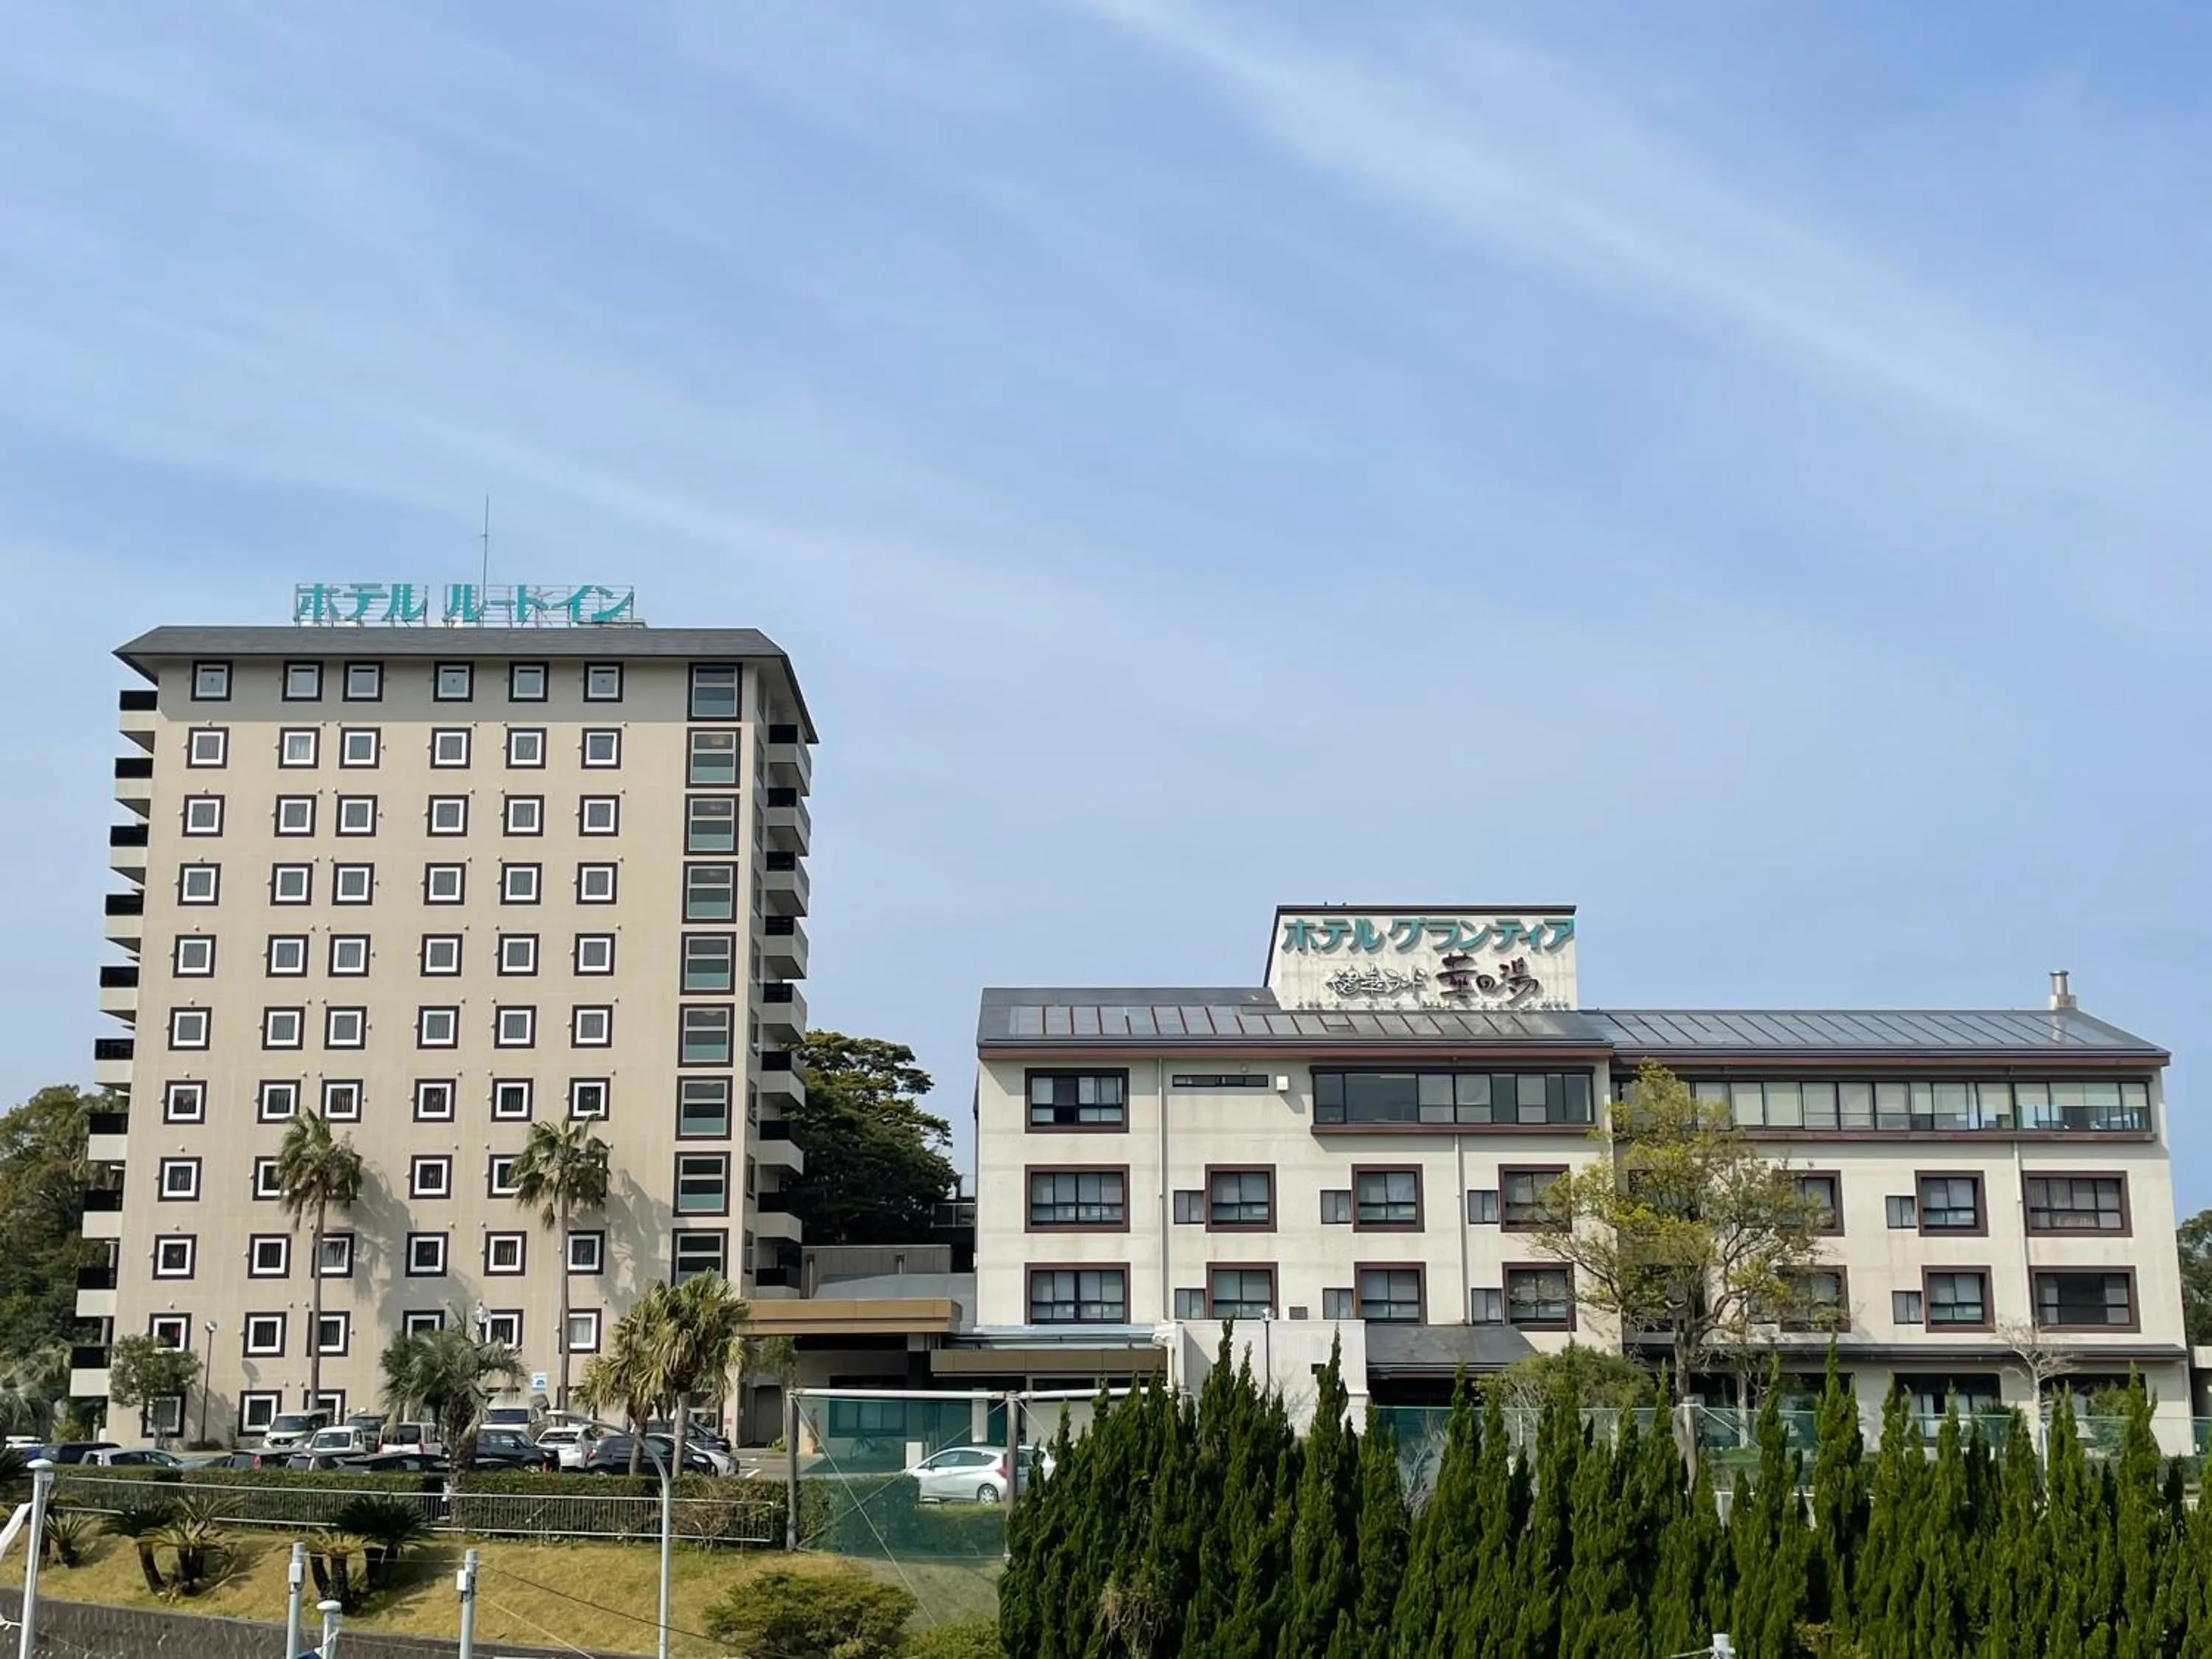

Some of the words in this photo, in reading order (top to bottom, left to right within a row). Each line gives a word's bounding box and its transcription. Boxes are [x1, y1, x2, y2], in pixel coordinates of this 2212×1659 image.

[293, 583, 428, 621] ホテル
[442, 583, 634, 622] ルートイン
